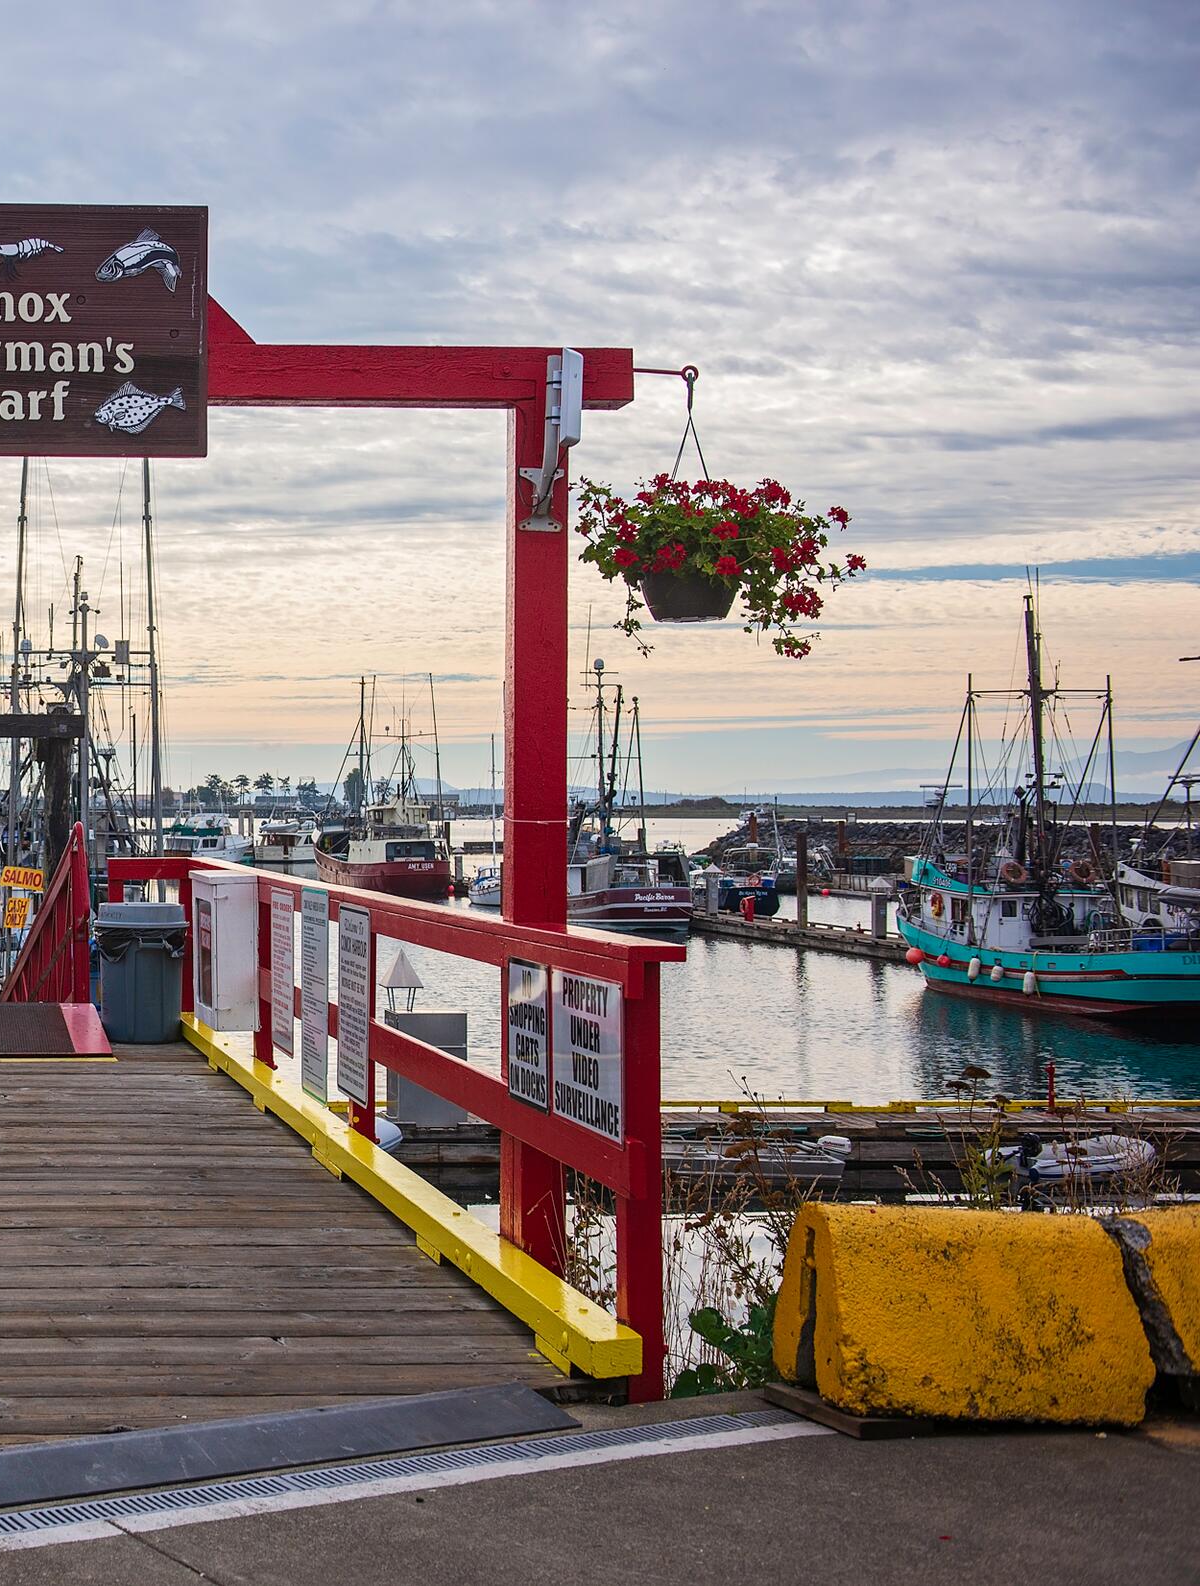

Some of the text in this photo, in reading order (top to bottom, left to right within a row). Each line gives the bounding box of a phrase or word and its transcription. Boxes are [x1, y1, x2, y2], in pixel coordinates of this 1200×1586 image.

[3, 869, 44, 888] SALMO
[7, 899, 28, 913] CASH
[634, 893, 675, 902] Pacific Baron
[521, 969, 532, 998] NO
[562, 976, 608, 1018] PROPERTY
[509, 999, 546, 1036] SHOPPING
[570, 1014, 600, 1053] UNDER
[515, 1032, 539, 1068] CARTS
[510, 1062, 546, 1104] ON DOCKS
[571, 1051, 599, 1091] VIDEO
[554, 1080, 620, 1138] SURVEILLANCE
